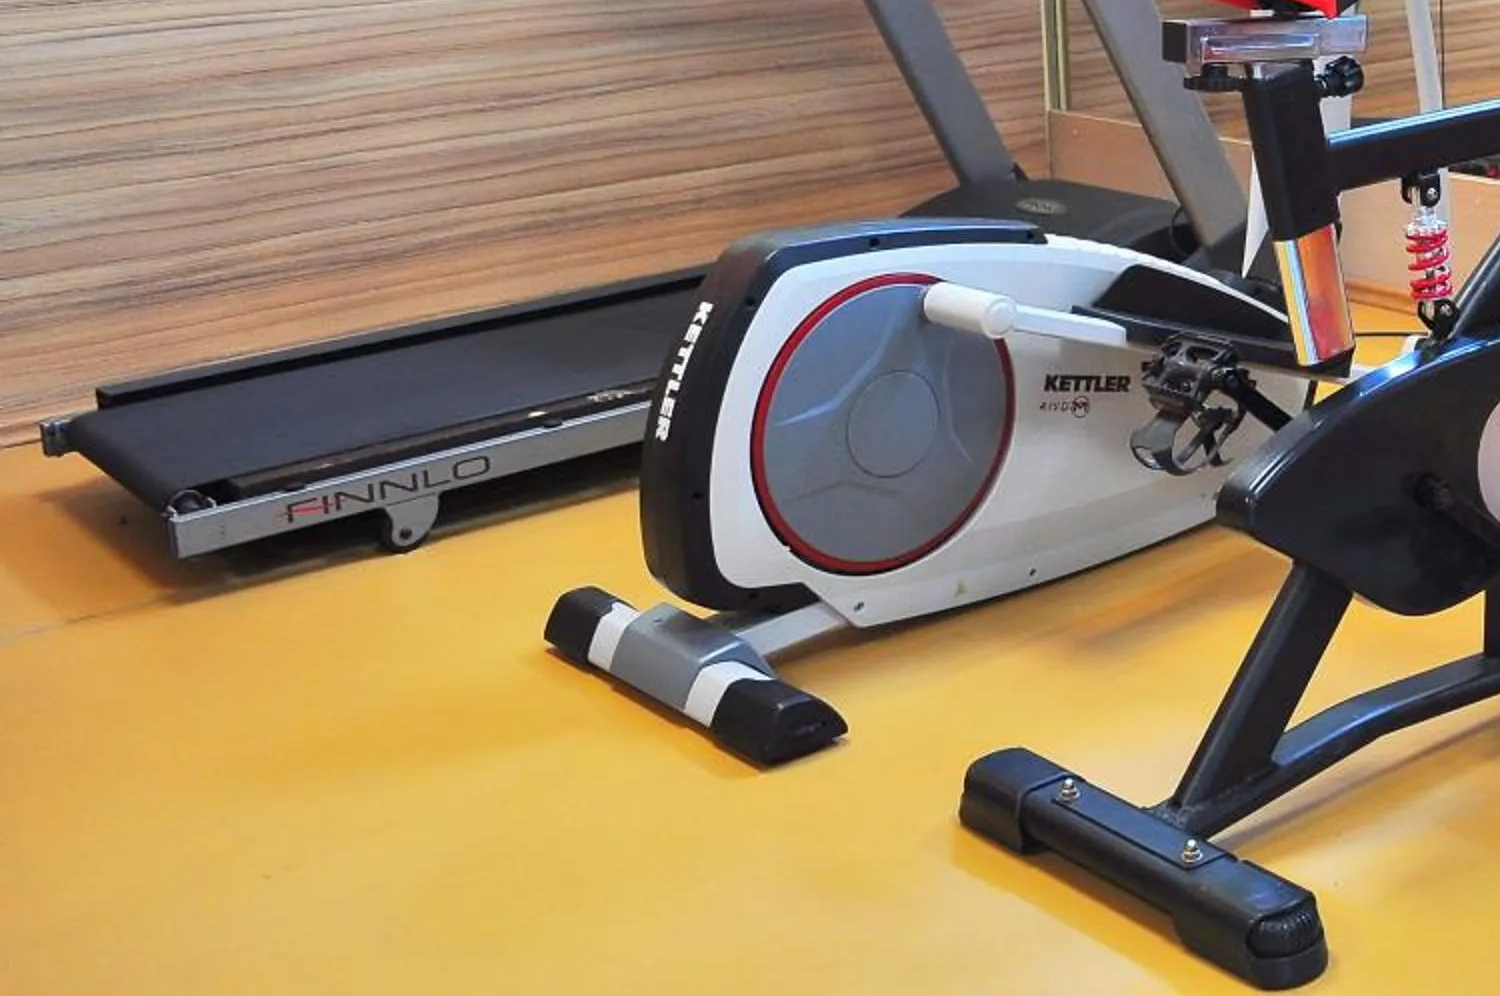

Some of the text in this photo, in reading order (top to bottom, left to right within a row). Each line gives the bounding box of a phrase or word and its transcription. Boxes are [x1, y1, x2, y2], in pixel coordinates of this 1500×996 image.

[654, 301, 713, 441] KETTLER
[1044, 374, 1131, 393] KETTLER
[279, 455, 491, 523] FINNLO
